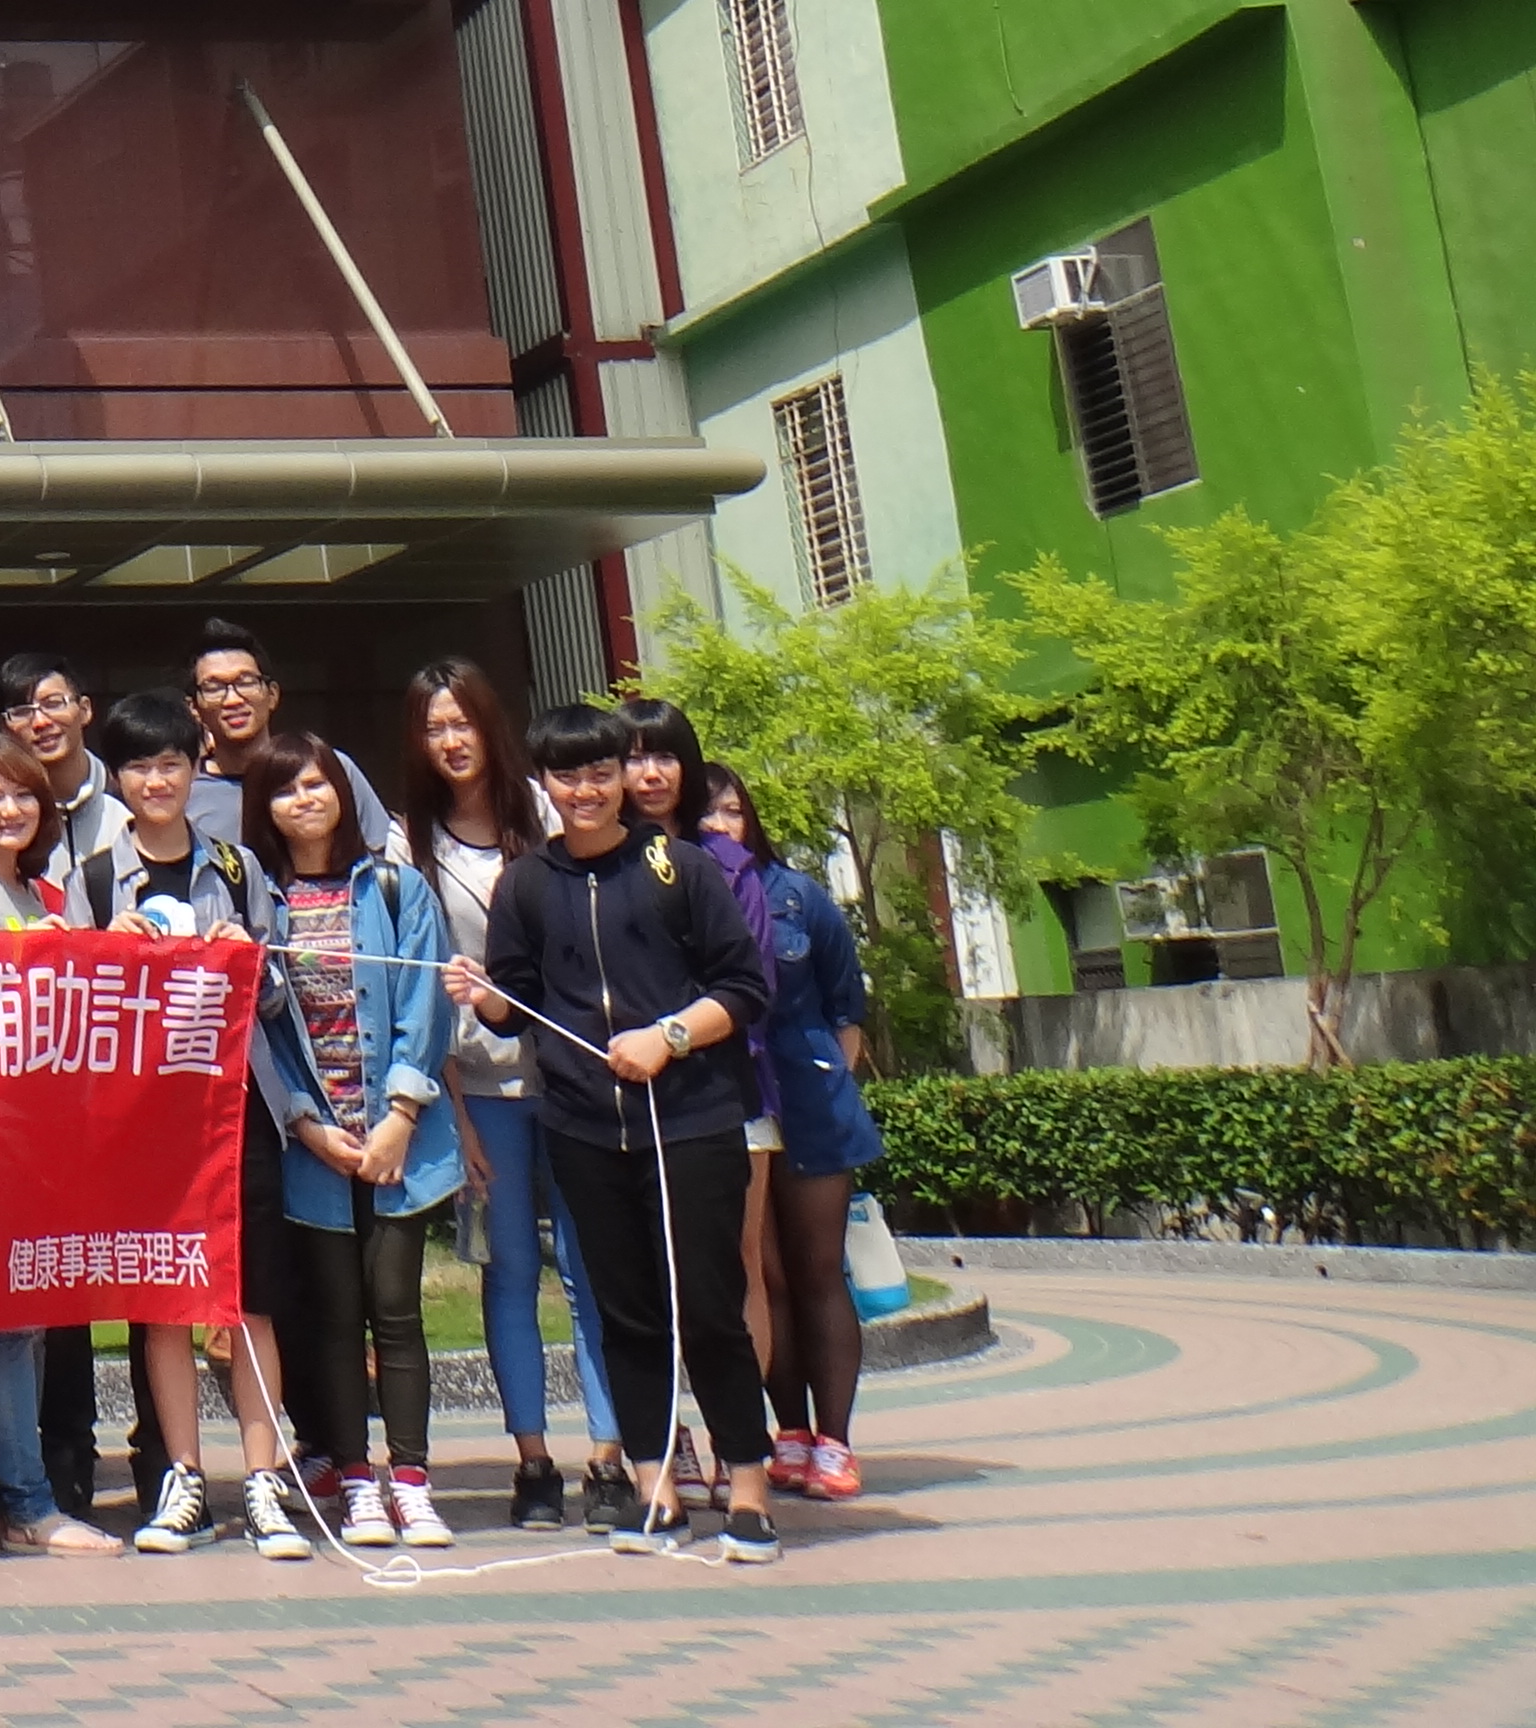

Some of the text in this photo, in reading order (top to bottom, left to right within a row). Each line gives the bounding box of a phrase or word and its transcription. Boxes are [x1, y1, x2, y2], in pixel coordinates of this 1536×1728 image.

[8, 1230, 211, 1294] 健康事業管理系
